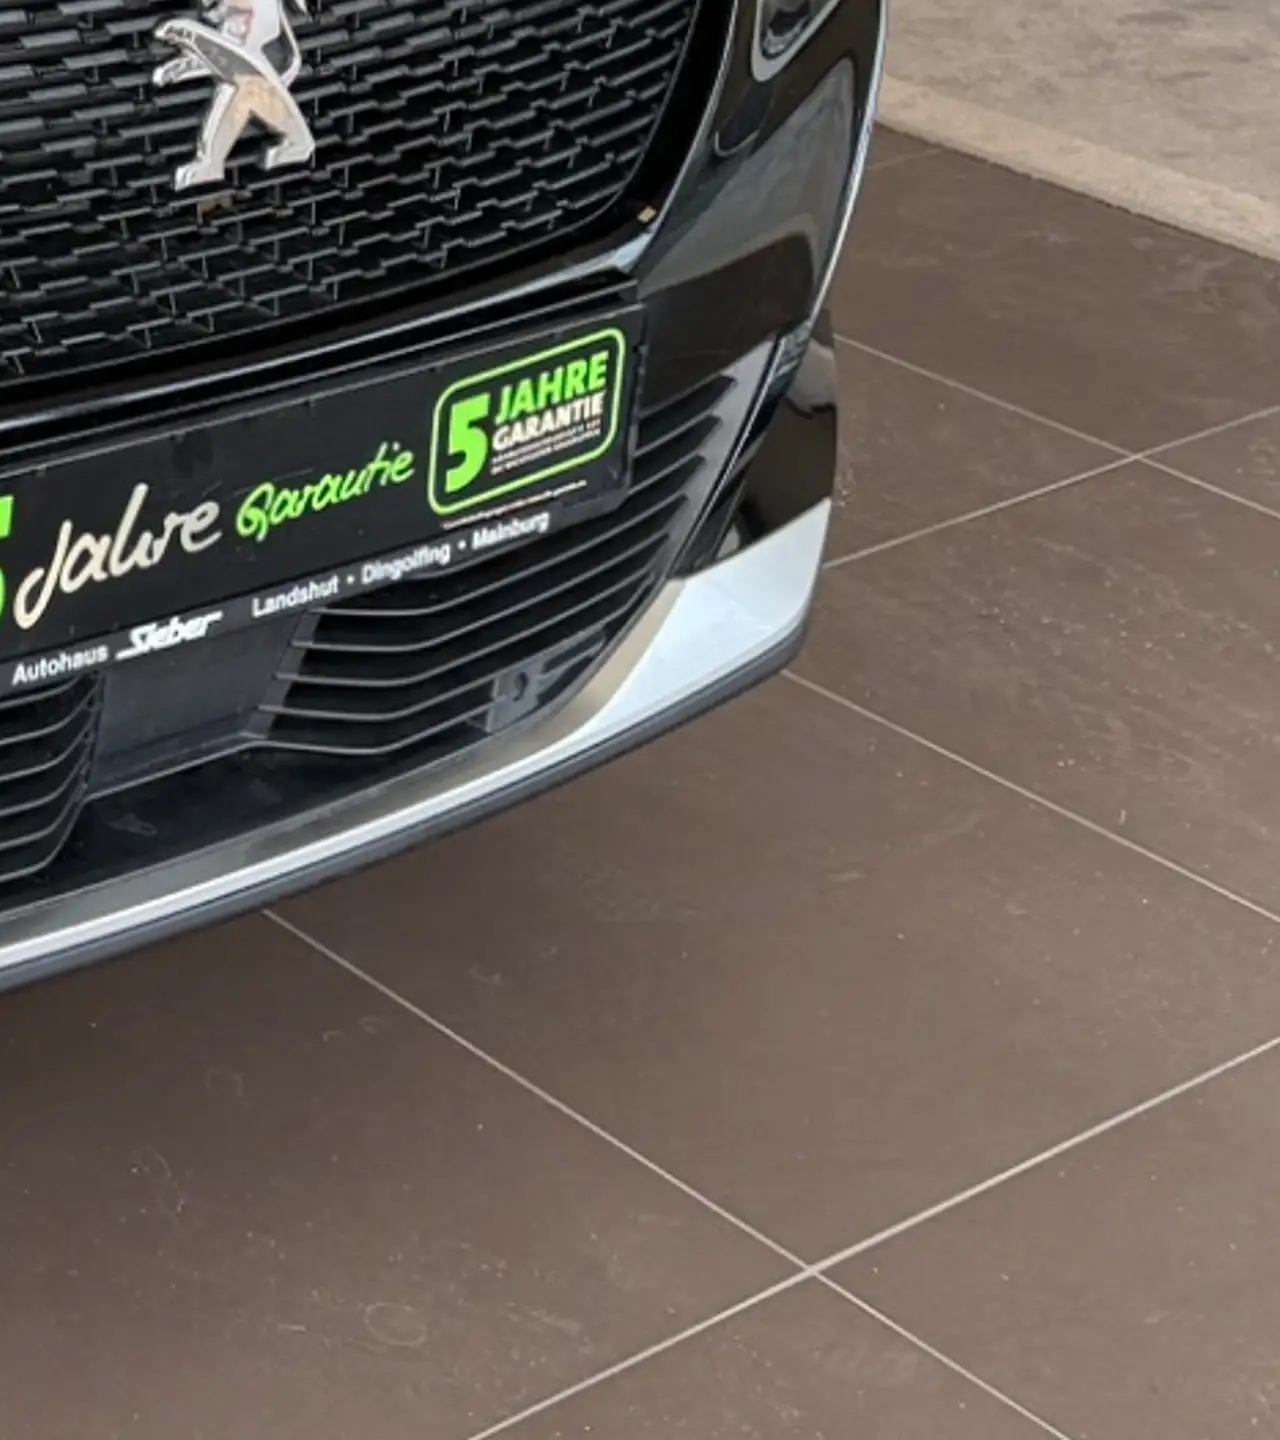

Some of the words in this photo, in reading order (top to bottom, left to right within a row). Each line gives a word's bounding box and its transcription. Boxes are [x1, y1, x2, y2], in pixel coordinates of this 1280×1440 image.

[444, 392, 491, 494] 5
[495, 350, 609, 426] JAHRE
[492, 390, 606, 452] GARANTIE
[11, 643, 109, 687] Autohaus
[251, 573, 340, 618] Landshut
[359, 541, 453, 585] Dingolfing
[471, 511, 552, 550] Mainburg
[13, 482, 222, 630] Jahre
[236, 440, 417, 543] Garantie
